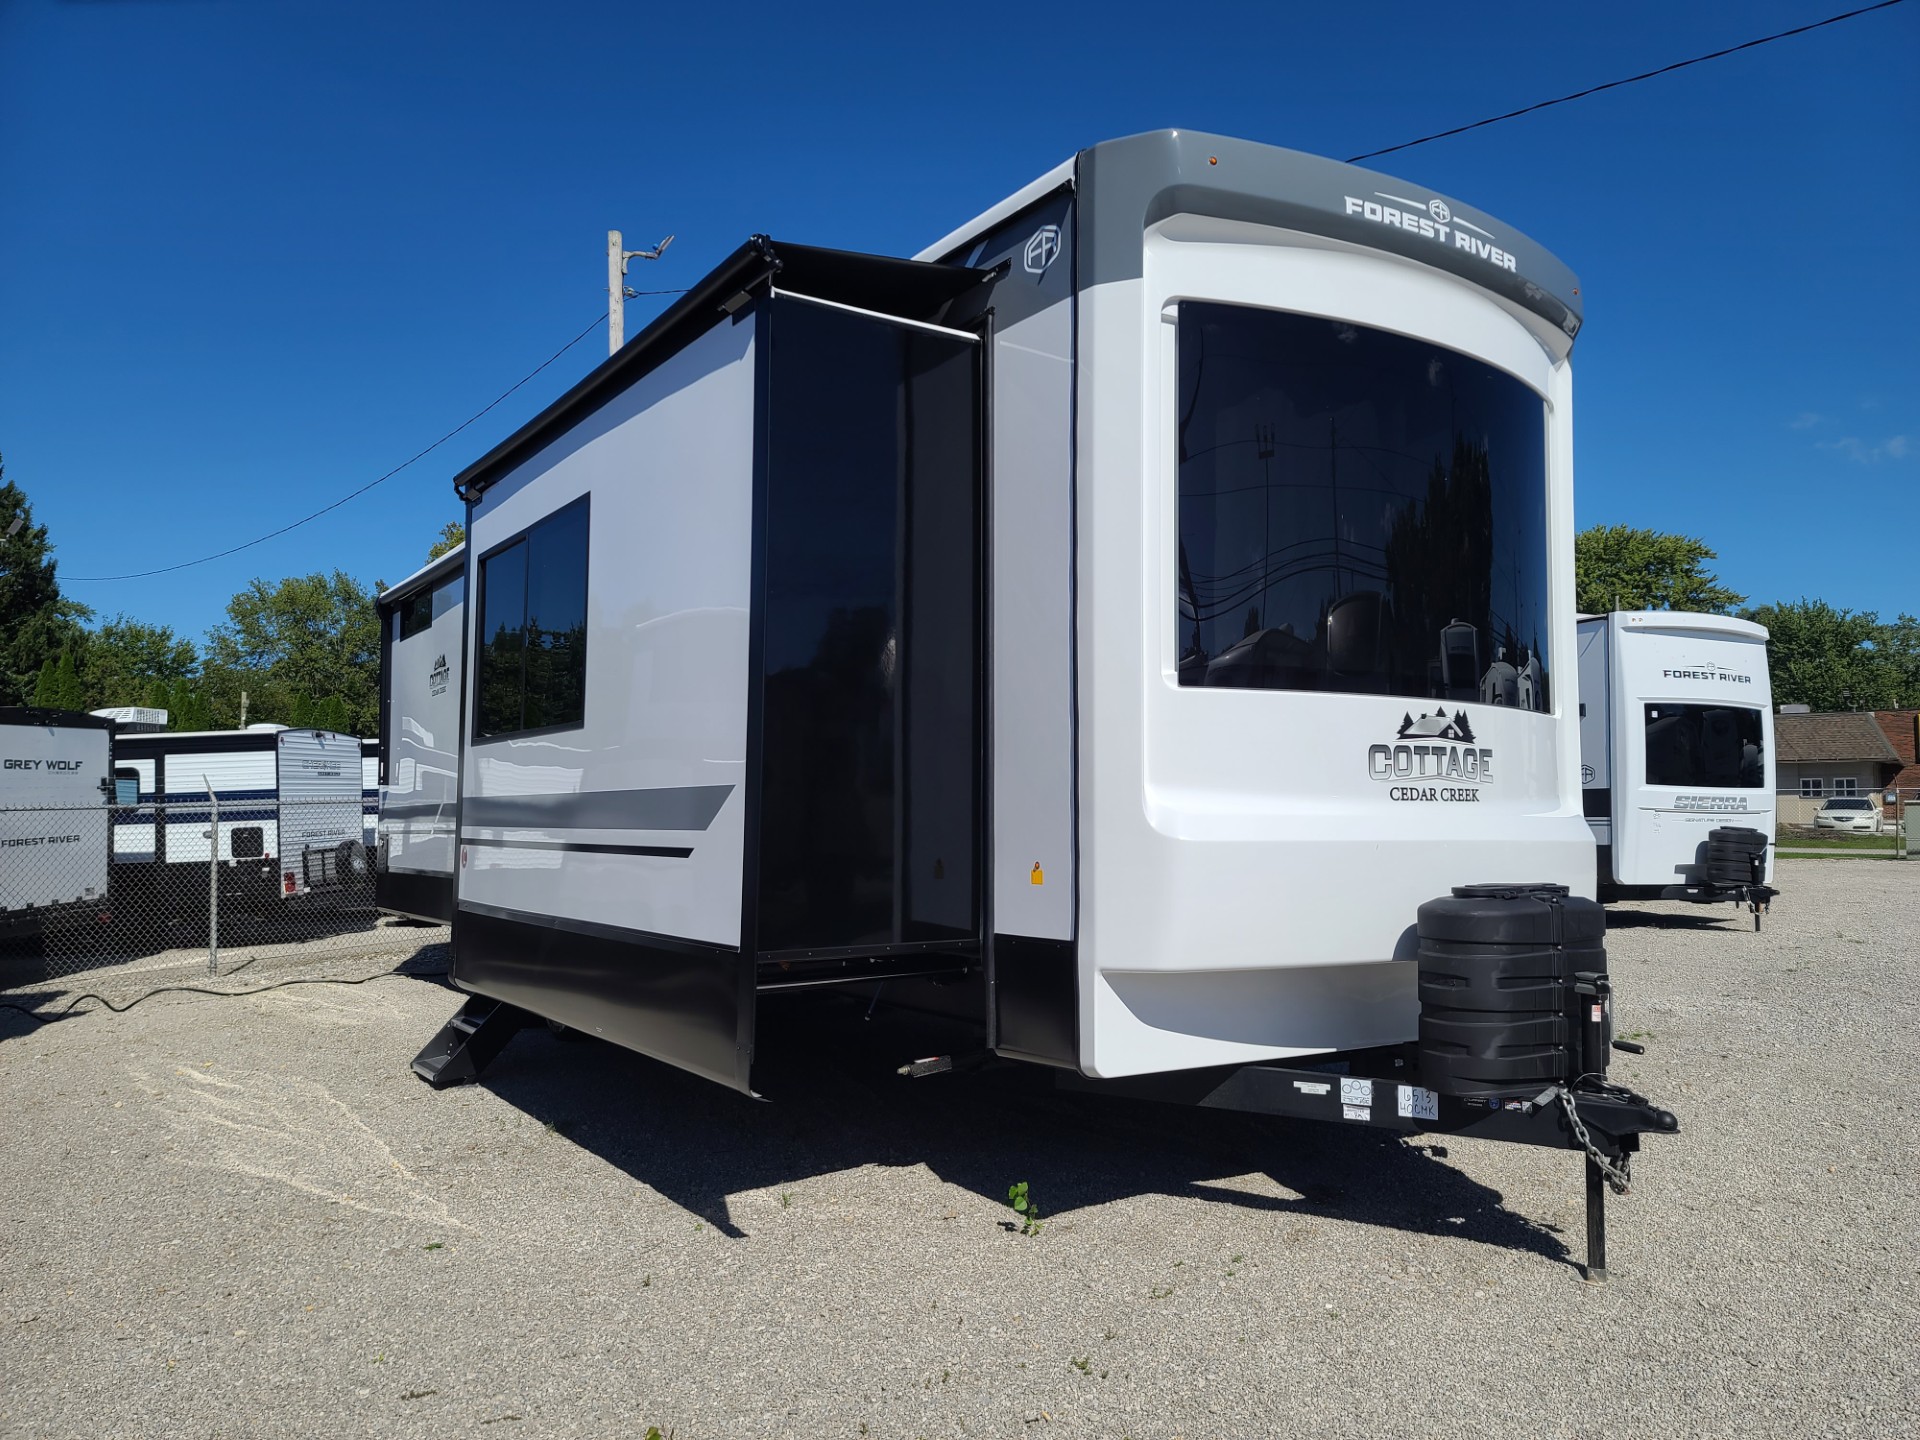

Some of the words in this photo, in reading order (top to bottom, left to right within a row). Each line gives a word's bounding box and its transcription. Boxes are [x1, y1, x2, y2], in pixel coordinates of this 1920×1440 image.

[1344, 195, 1450, 242] FOREST
[1455, 229, 1516, 273] RIVER
[1662, 669, 1716, 680] FOREST
[1719, 673, 1751, 684] RIVER
[4, 759, 42, 770] GREY
[46, 760, 83, 770] WOLF
[1368, 744, 1494, 785] COTTAGE
[1389, 787, 1438, 801] CEDAR
[1440, 788, 1480, 802] CREEK
[1673, 795, 1748, 811] SIERRA
[1, 837, 45, 848] FOREST
[48, 835, 80, 844] RIVER
[1403, 1087, 1432, 1104] 6513
